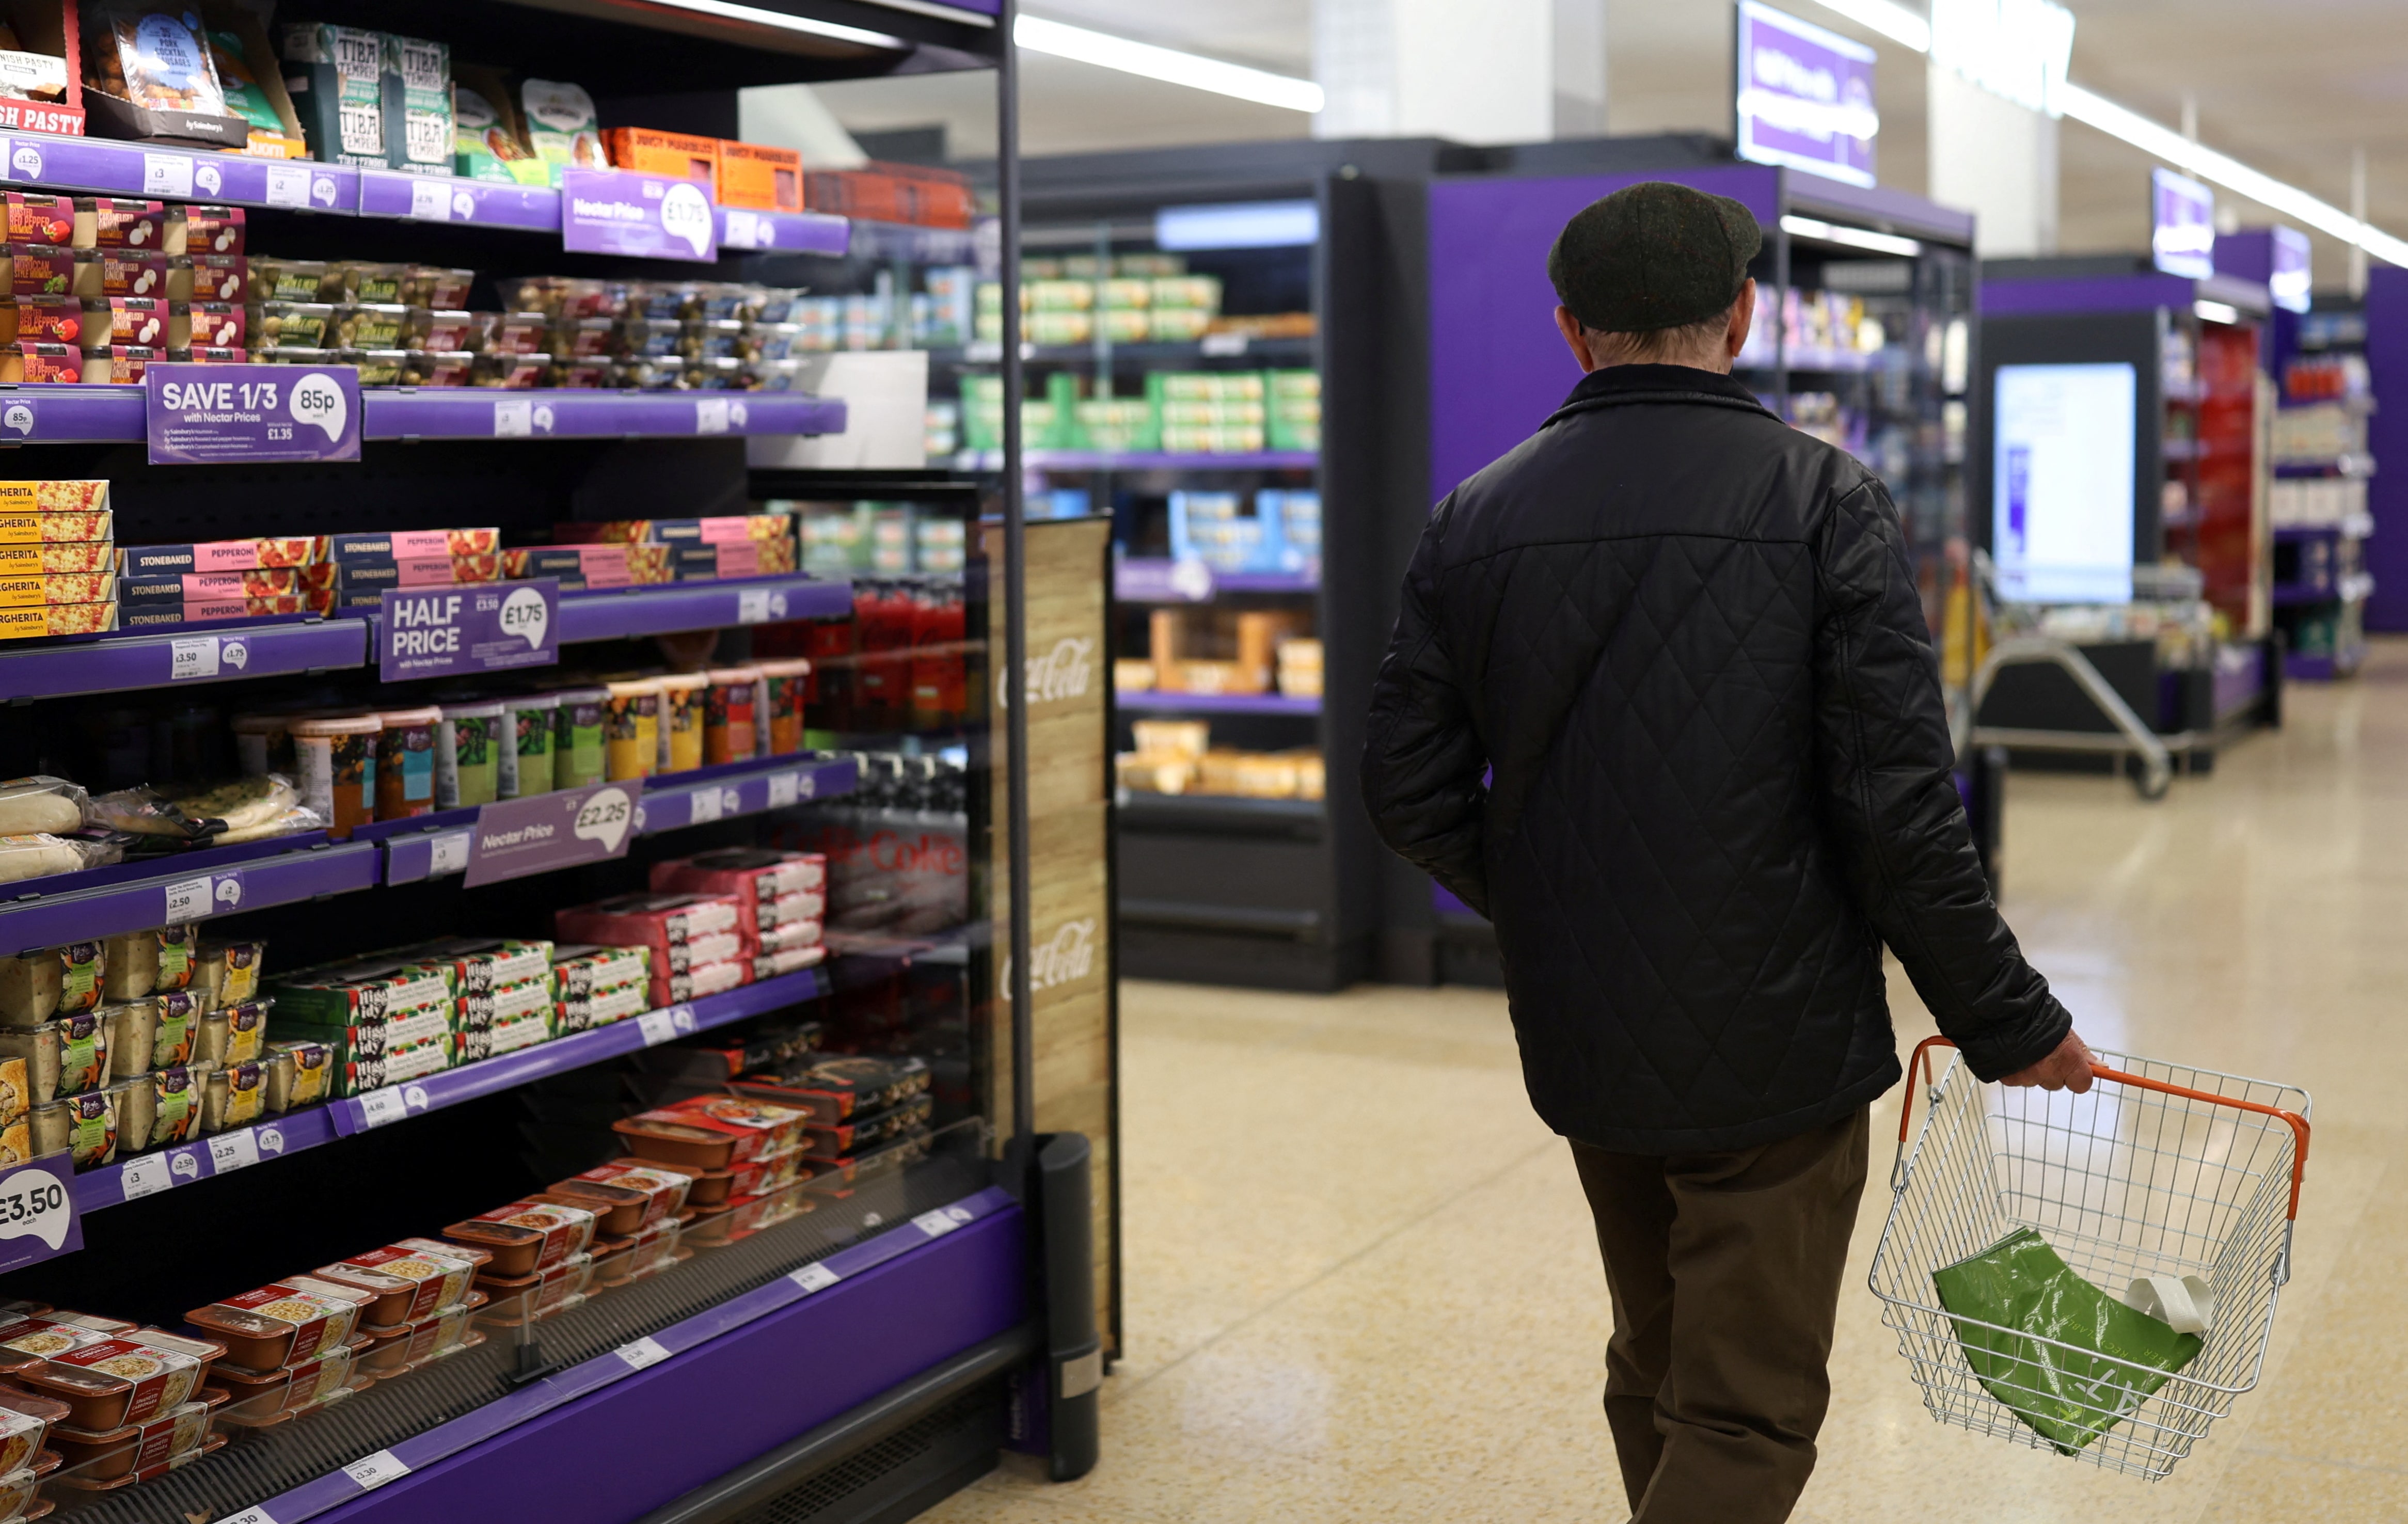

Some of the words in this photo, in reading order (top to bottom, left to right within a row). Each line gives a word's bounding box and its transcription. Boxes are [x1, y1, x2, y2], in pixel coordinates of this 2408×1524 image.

[159, 38, 179, 49] PORK
[338, 38, 377, 64] TIBA
[25, 57, 54, 69] PASTY
[404, 49, 439, 73] TIBA
[338, 62, 376, 81] TEMPEH
[25, 109, 83, 134] PASTY
[340, 110, 377, 135] TIBA
[407, 121, 442, 143] TIBA
[342, 132, 378, 152] TEMPEH
[19, 155, 39, 165] £1.25
[155, 168, 164, 178] £3
[573, 197, 613, 219] Nectar
[613, 200, 645, 221] Price
[9, 215, 23, 226] RED
[24, 216, 50, 227] PEPPER
[14, 259, 50, 272] MOROCCAN
[104, 262, 139, 272] CARAMELISED
[13, 269, 29, 278] STYLE
[104, 270, 125, 281] ONION
[19, 315, 33, 327] RED
[33, 316, 60, 327] PEPPER
[112, 311, 145, 322] CARAMELISED
[112, 319, 132, 330] ONION
[37, 366, 60, 376] PEPPER
[113, 360, 144, 371] CARAMELISED
[163, 383, 234, 410] SAVE
[239, 383, 278, 410] 1/3
[300, 390, 335, 414] 85p
[12, 412, 27, 423] 85p
[183, 413, 202, 423] with
[203, 412, 234, 423] Nectar
[234, 412, 261, 423] Prices
[267, 428, 292, 440] £1.35
[344, 542, 390, 553] STONEBAKED
[407, 537, 445, 546] PEPPERONI
[211, 548, 254, 558] PEPPERONI
[140, 554, 193, 567] STONEBAKED
[351, 568, 397, 580] STONEBAKED
[413, 563, 450, 573] PEPPERONI
[199, 576, 240, 587] PEPPERONI
[131, 583, 181, 596] STONEBAKED
[351, 595, 382, 606] STONEBA
[201, 606, 244, 617] PEPPERONI
[393, 595, 462, 629] HALF
[505, 604, 543, 625] £1.75
[129, 613, 182, 626] STONEBAKED
[20, 624, 44, 632] Sainsbury's
[392, 627, 462, 657] PRICE
[176, 653, 197, 663] £3.50
[227, 648, 244, 657] £1.75
[399, 659, 413, 669] with
[413, 658, 433, 668] Nectar
[433, 657, 453, 666] Prices
[577, 802, 628, 828] £2.25
[482, 829, 524, 851] Nectar
[523, 824, 556, 842] Price
[225, 886, 233, 895] £2
[169, 896, 191, 910] £2.50
[263, 1134, 279, 1145] £1.75
[215, 1146, 235, 1160] £2.25
[176, 1158, 194, 1170] £2.50
[131, 1172, 140, 1184] £3
[22, 1217, 37, 1226] each
[132, 1399, 157, 1411] CARBONARA
[135, 1393, 159, 1405] SPAGHETTI
[142, 1444, 168, 1456] CARBONARA
[146, 1438, 169, 1450] SPAGHETTI
[356, 1467, 377, 1480] £3.30
